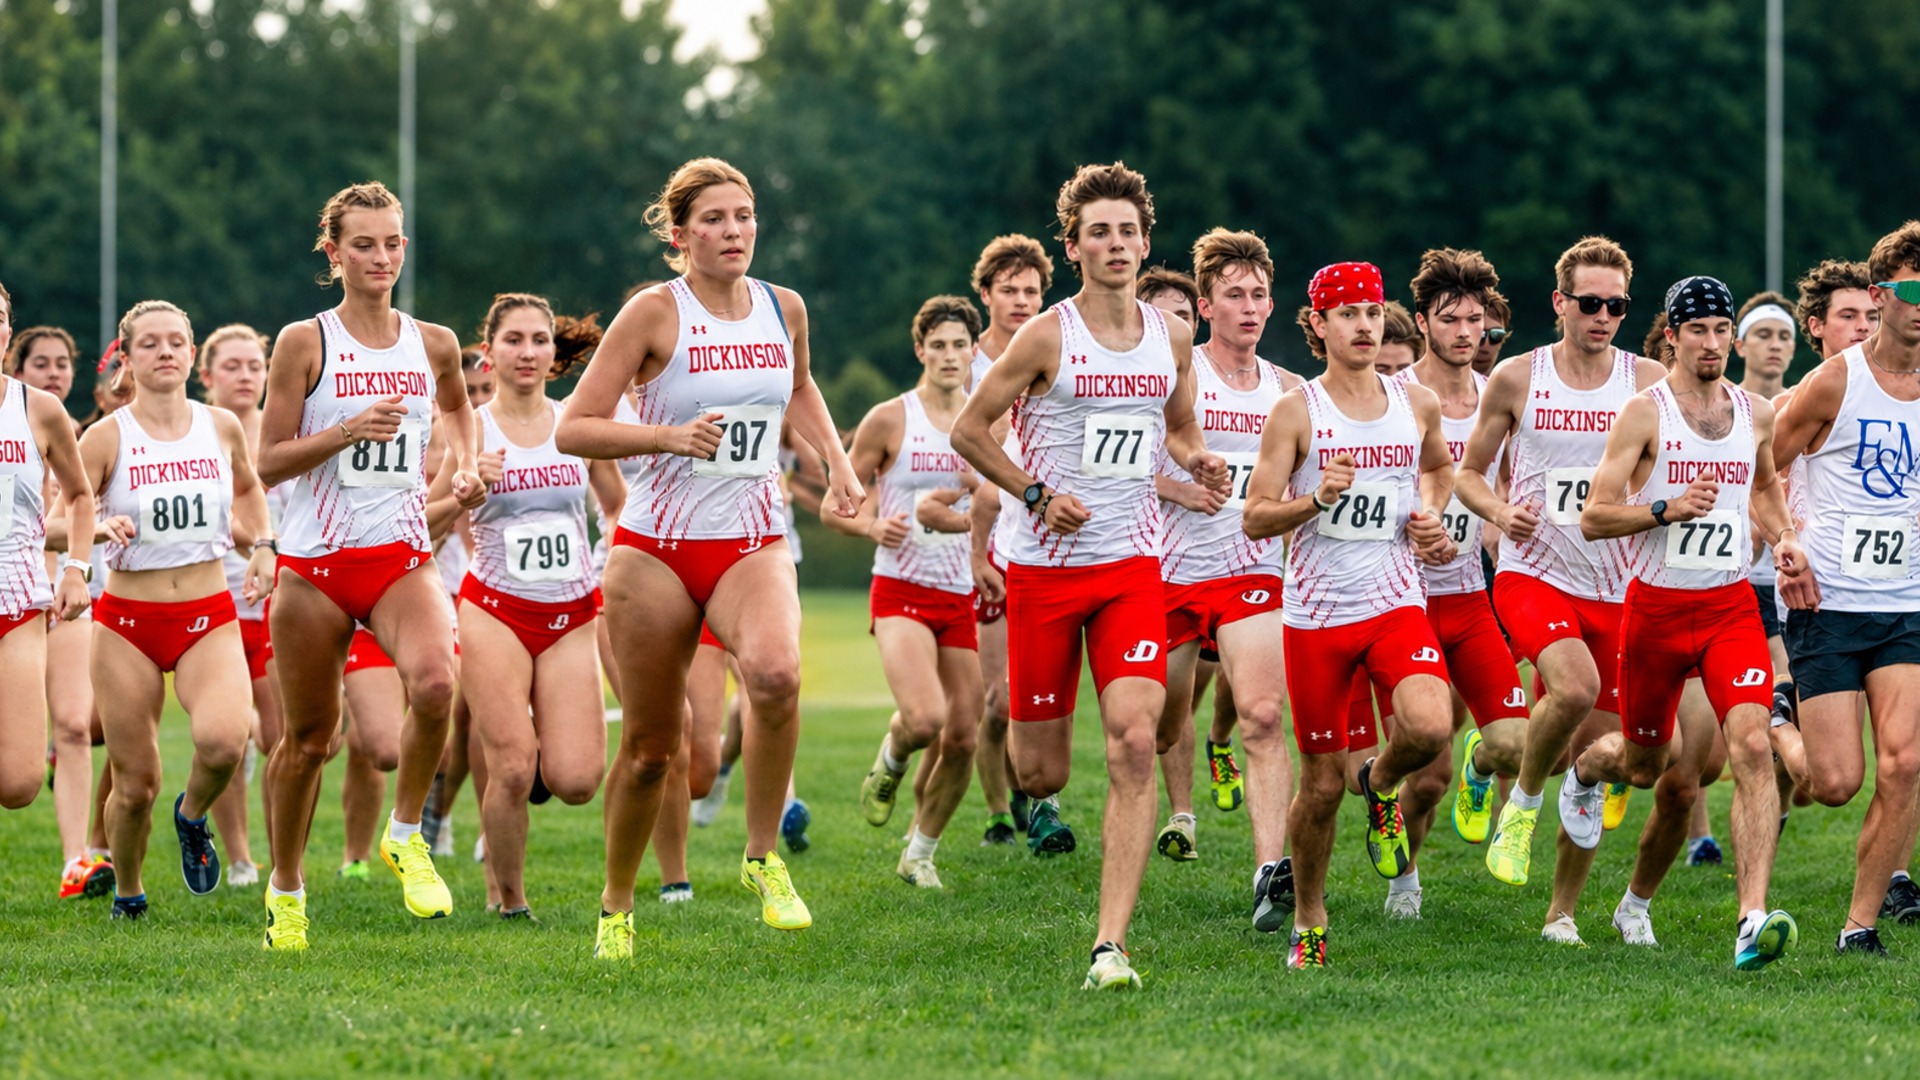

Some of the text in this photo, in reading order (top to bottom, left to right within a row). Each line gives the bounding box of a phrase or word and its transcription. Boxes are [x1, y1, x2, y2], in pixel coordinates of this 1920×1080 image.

[688, 343, 788, 373] DICKINSON
[335, 371, 428, 398] DICKINSON
[1074, 374, 1168, 399] DICKINSON
[352, 433, 408, 473] 811
[1093, 428, 1144, 465] 777
[129, 458, 220, 491] DICKINSON
[152, 493, 207, 532] 801
[1330, 494, 1387, 529] 784
[517, 533, 570, 571] 799
[1678, 523, 1733, 557] 772
[1852, 529, 1905, 565] 752
